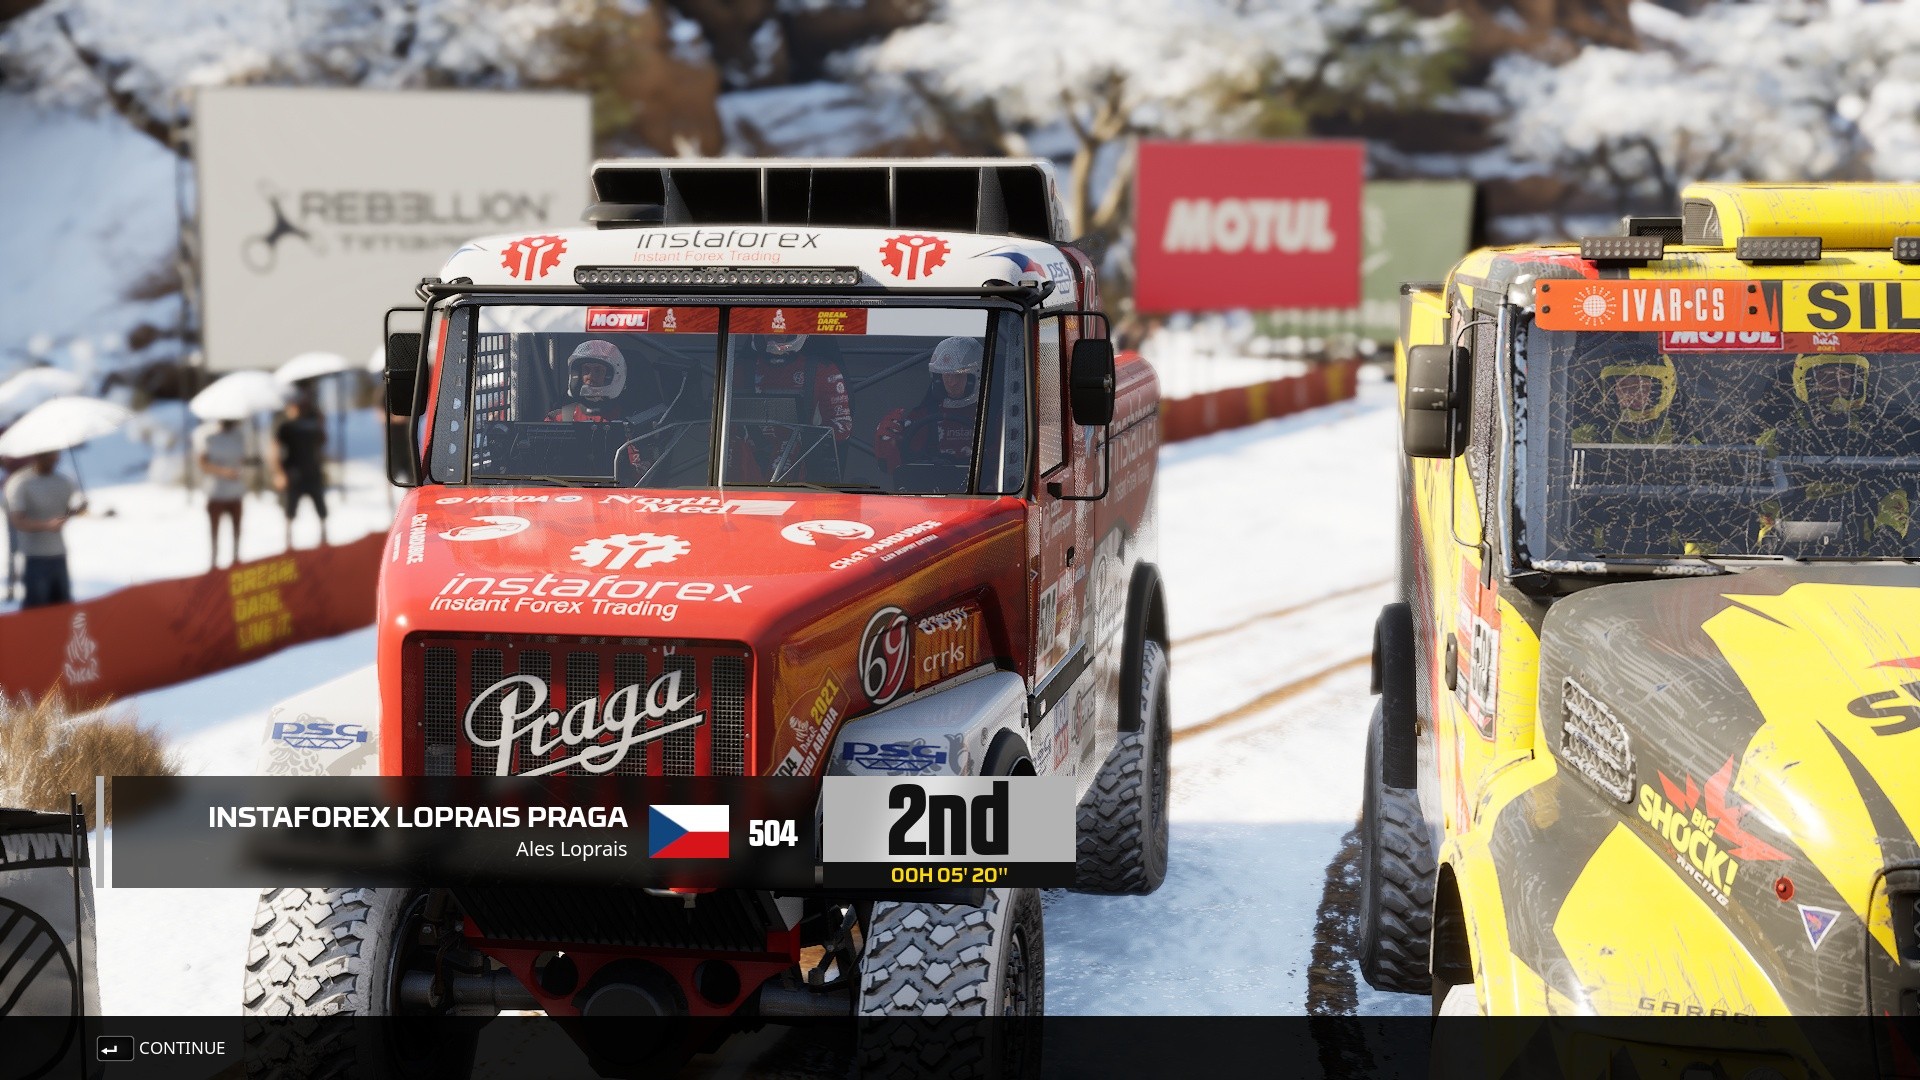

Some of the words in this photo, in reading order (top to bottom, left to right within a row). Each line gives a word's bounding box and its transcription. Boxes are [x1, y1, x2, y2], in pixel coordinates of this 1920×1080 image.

[636, 230, 821, 248] instaforex
[1162, 198, 1336, 253] MOTUL
[633, 250, 680, 262] Instant
[685, 251, 724, 262] Forex
[729, 251, 780, 264] Trading
[591, 314, 645, 327] MOTUL
[817, 311, 848, 319] DREAM.
[598, 494, 722, 506] North
[635, 503, 732, 514] Med
[438, 572, 752, 604] instaforex
[429, 596, 511, 612] Instant
[514, 597, 585, 614] Forex
[592, 599, 679, 622] Trading
[810, 678, 840, 726] 2021
[464, 670, 702, 776] Praga
[797, 751, 817, 776] UDI
[812, 707, 839, 755] ARABIA
[775, 757, 798, 776] 04
[1691, 807, 1716, 838] BIG
[1638, 784, 1739, 897] SHOCK!
[1676, 853, 1729, 906] RACING
